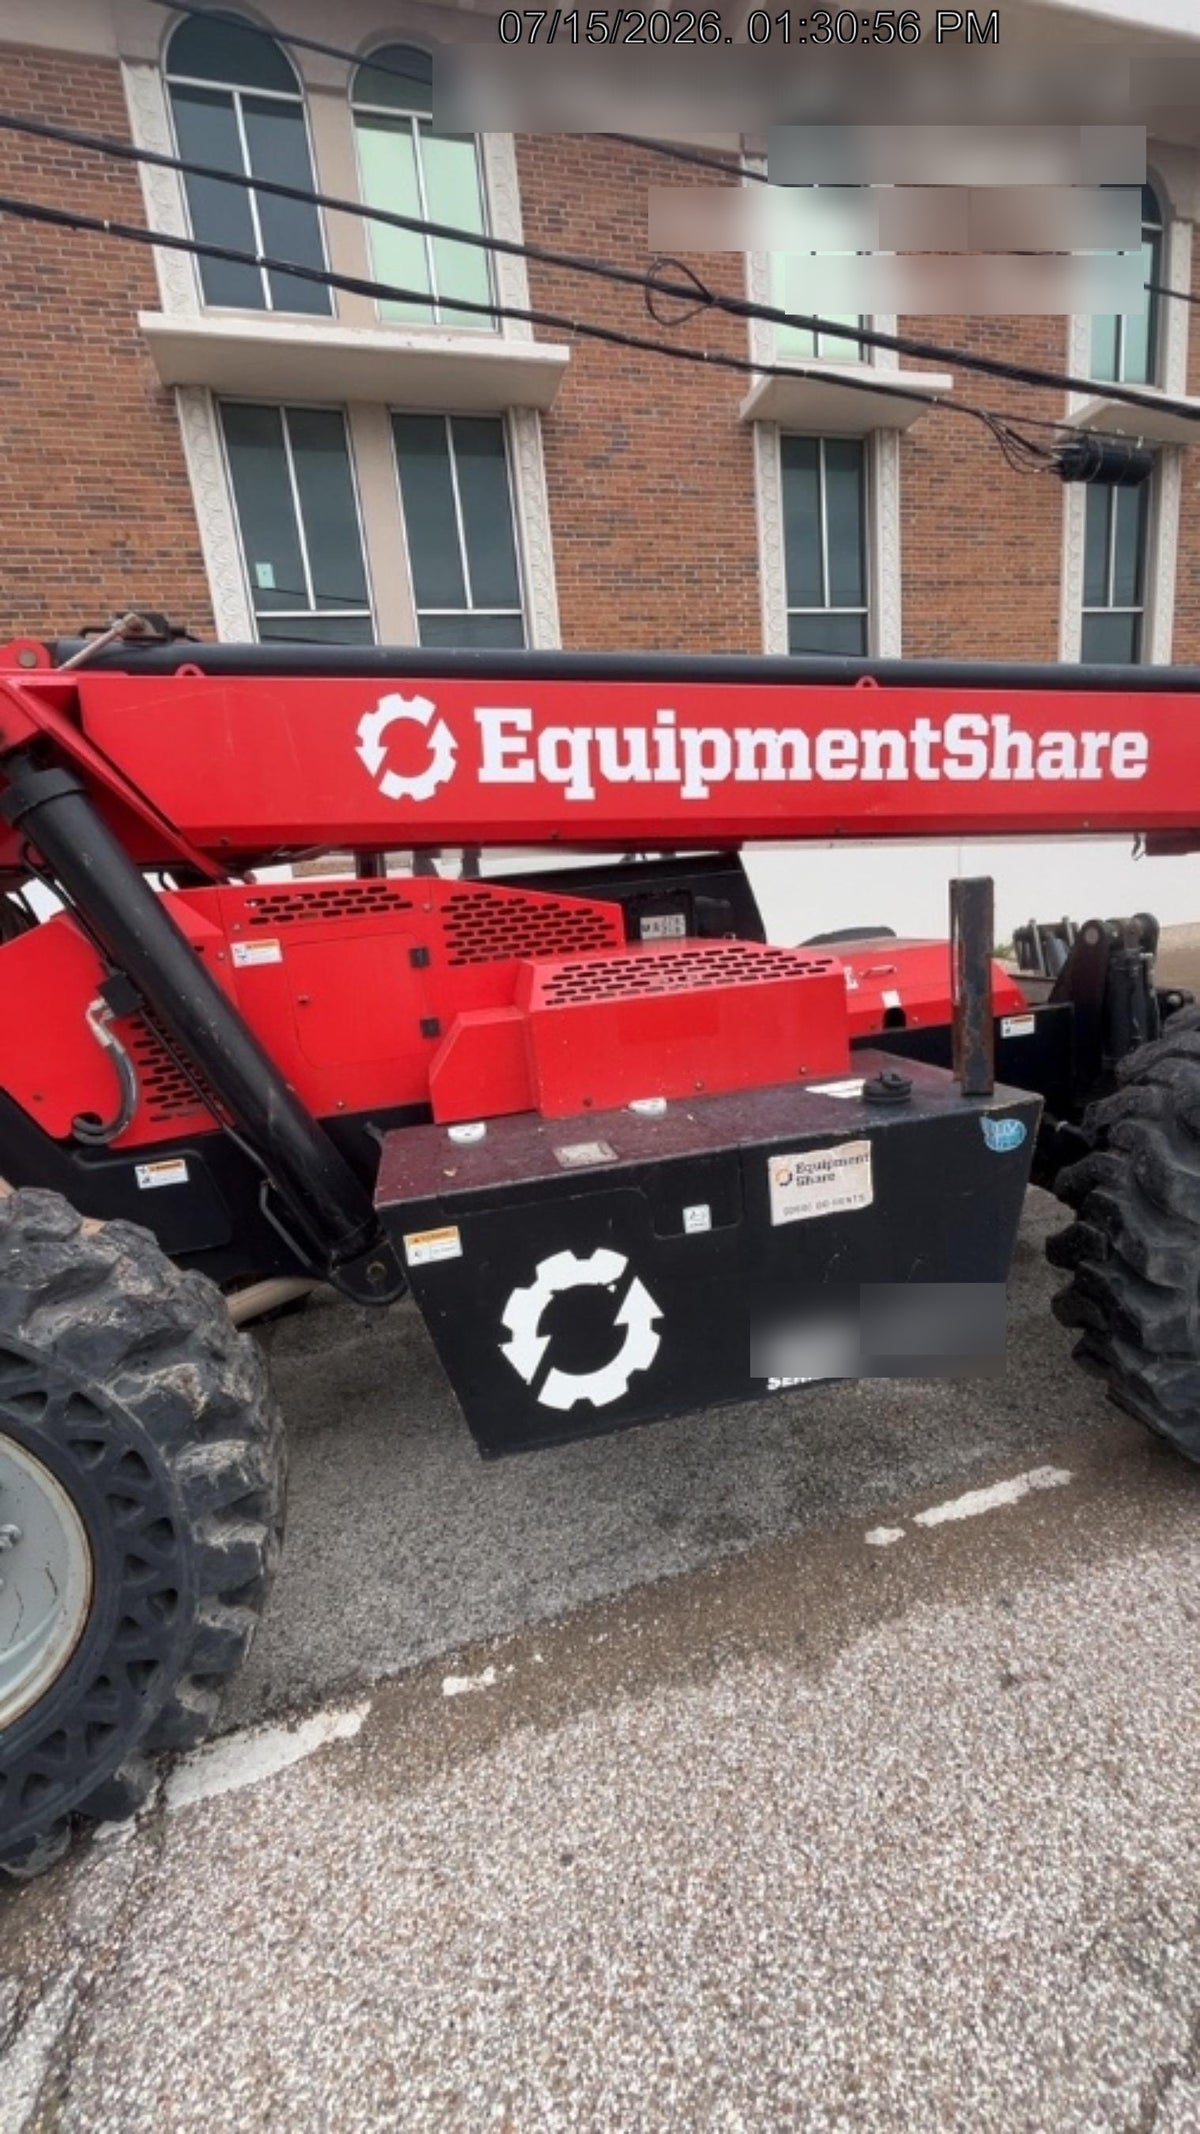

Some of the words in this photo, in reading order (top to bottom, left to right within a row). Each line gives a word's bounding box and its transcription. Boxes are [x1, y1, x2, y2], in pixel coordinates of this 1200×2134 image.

[474, 707, 1149, 800] EquipmentShare
[796, 1153, 869, 1174] Equipment
[796, 1173, 836, 1187] Share
